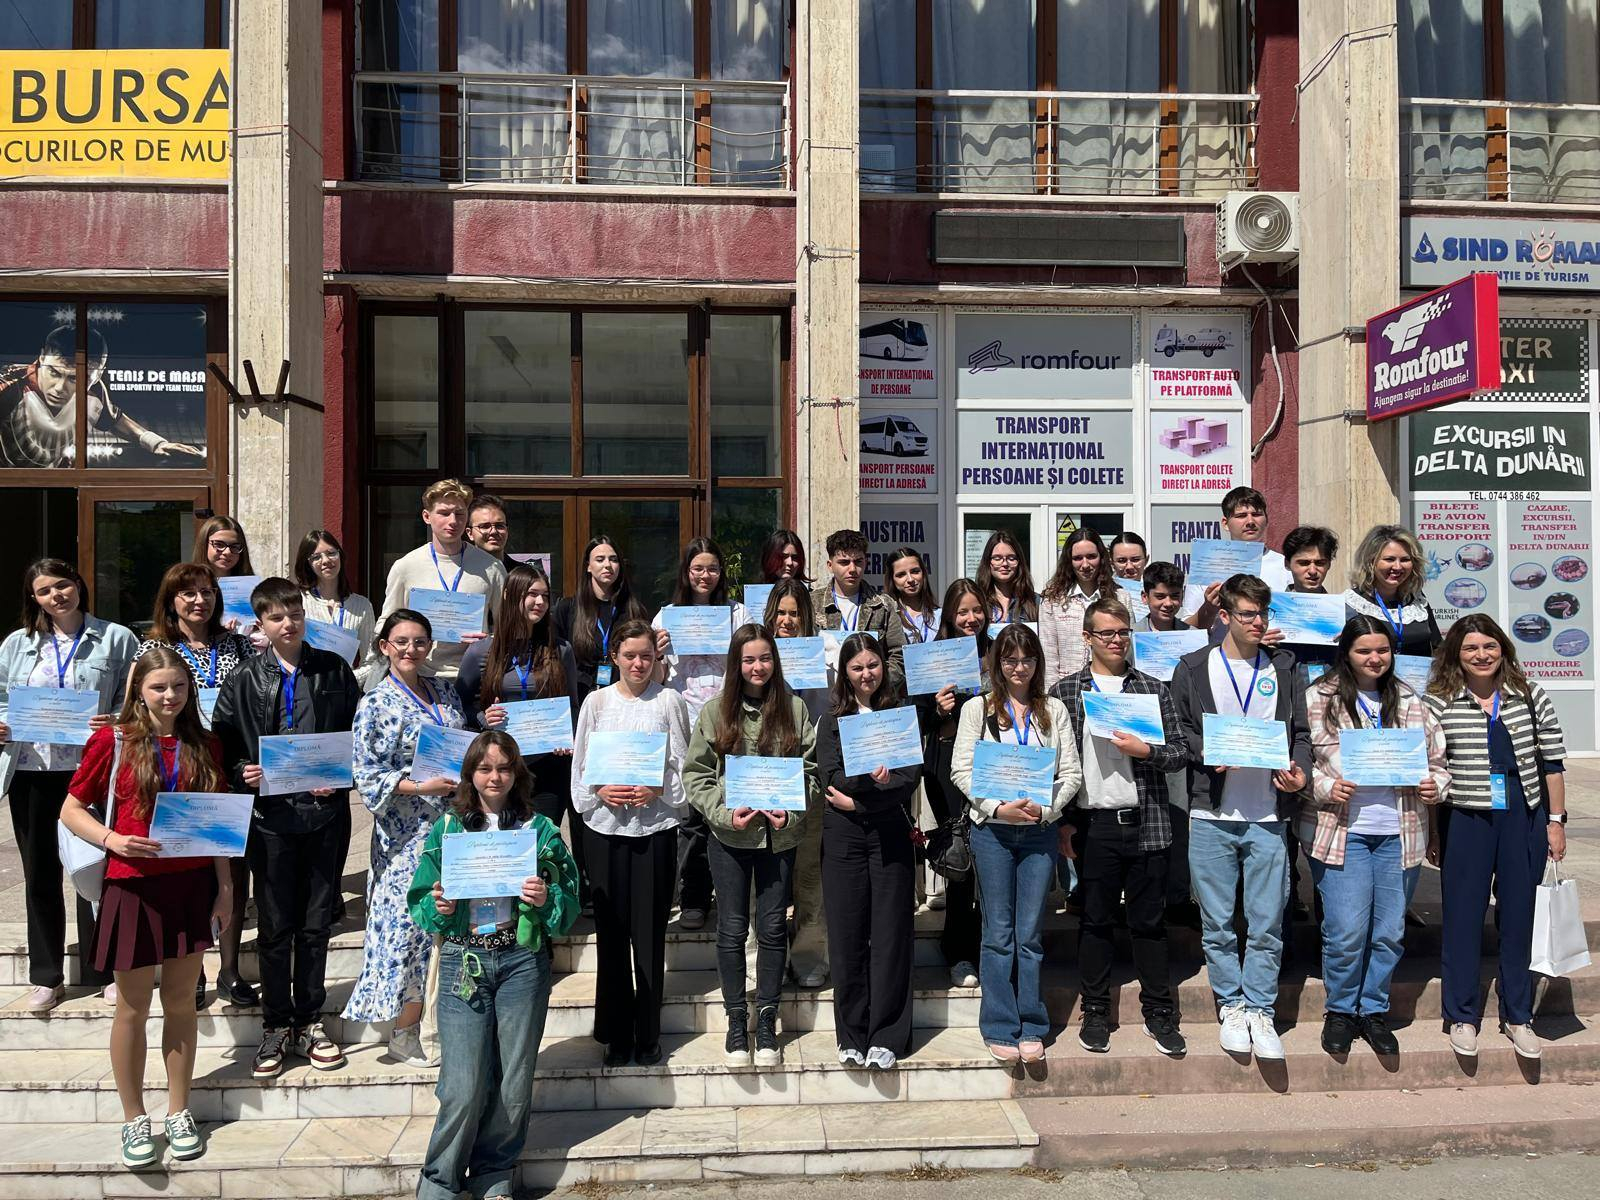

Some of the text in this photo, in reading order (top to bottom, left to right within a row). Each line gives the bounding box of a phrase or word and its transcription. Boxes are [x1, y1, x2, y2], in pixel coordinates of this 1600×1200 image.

[12, 67, 229, 124] BURSA
[0, 139, 228, 162] CURILOR DE MU
[1442, 237, 1508, 262] SIND
[1525, 271, 1540, 281] DE
[1544, 272, 1589, 282] TURISM
[1021, 350, 1120, 369] romfour
[1374, 341, 1468, 392] Romfour
[107, 369, 206, 383] TENIS DE MASA
[1152, 370, 1240, 381] TRANSPORT AUTO
[109, 383, 126, 391] CLUB
[165, 384, 182, 392] TEAM
[182, 384, 204, 392] TULCEA
[871, 384, 912, 395] DE PERSOANE
[1160, 385, 1172, 396] PE
[1374, 393, 1403, 408] Ajungem
[1404, 386, 1423, 400] sigur
[1423, 383, 1430, 393] la
[995, 417, 1090, 434] TRANSPORT
[1433, 424, 1567, 450] EXCURSII IN
[981, 442, 1105, 465] INTERNAȚIONAL
[1414, 450, 1488, 476] DELTA
[895, 464, 935, 475] PERSOANE
[1160, 464, 1233, 475] TRANSPORT COLETE
[885, 478, 895, 489] LA
[962, 468, 1124, 490] PERSOANE ȘI COLETE
[1162, 479, 1190, 490] DIRECT
[1191, 479, 1201, 490] LA
[1469, 491, 1540, 501] TEL. 0744 386 462
[1429, 503, 1479, 511] BILETE
[860, 521, 925, 542] AUSTRIA
[1418, 523, 1491, 531] TRANSFER
[1417, 533, 1492, 541] AEROPORT
[1545, 543, 1589, 551] DUNARII
